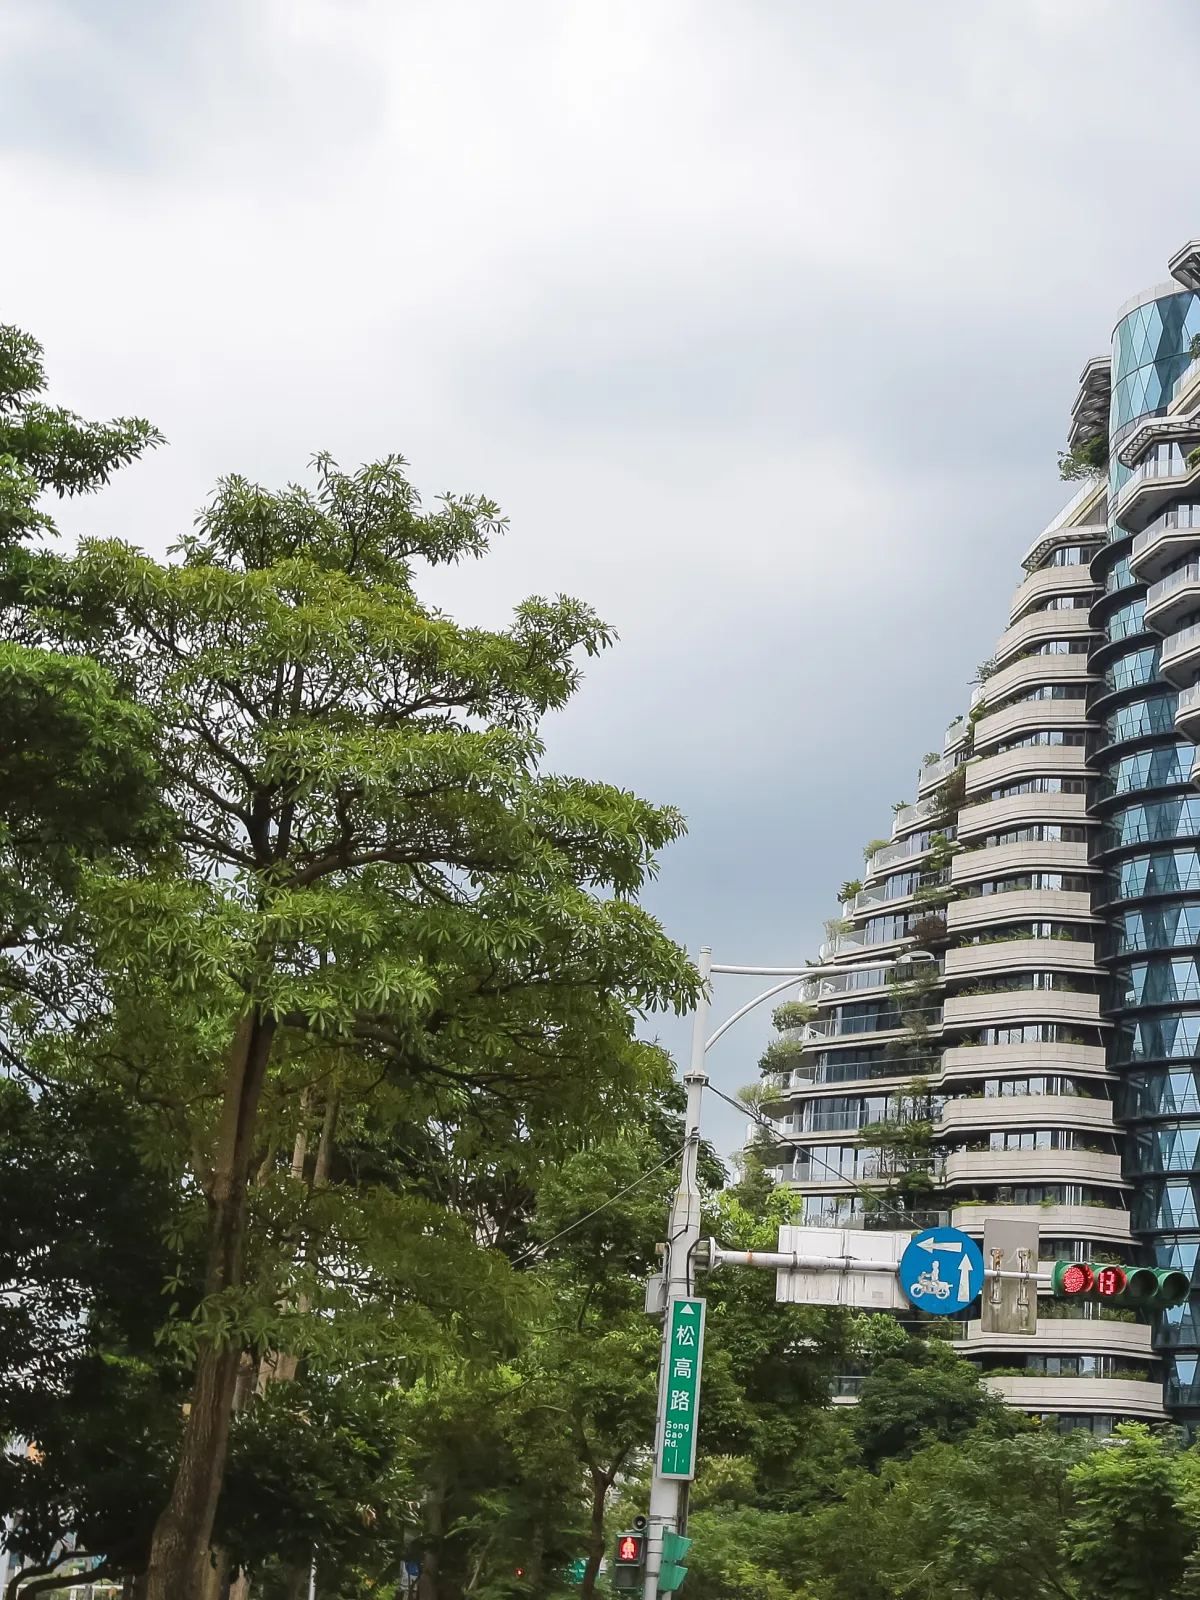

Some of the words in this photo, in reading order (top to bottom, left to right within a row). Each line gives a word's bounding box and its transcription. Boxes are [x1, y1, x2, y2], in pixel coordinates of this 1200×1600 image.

[1099, 1271, 1115, 1295] 13
[671, 1324, 696, 1411] 松高路
[665, 1420, 690, 1433] Song
[665, 1430, 683, 1439] Gao
[664, 1438, 679, 1448] Rd.
